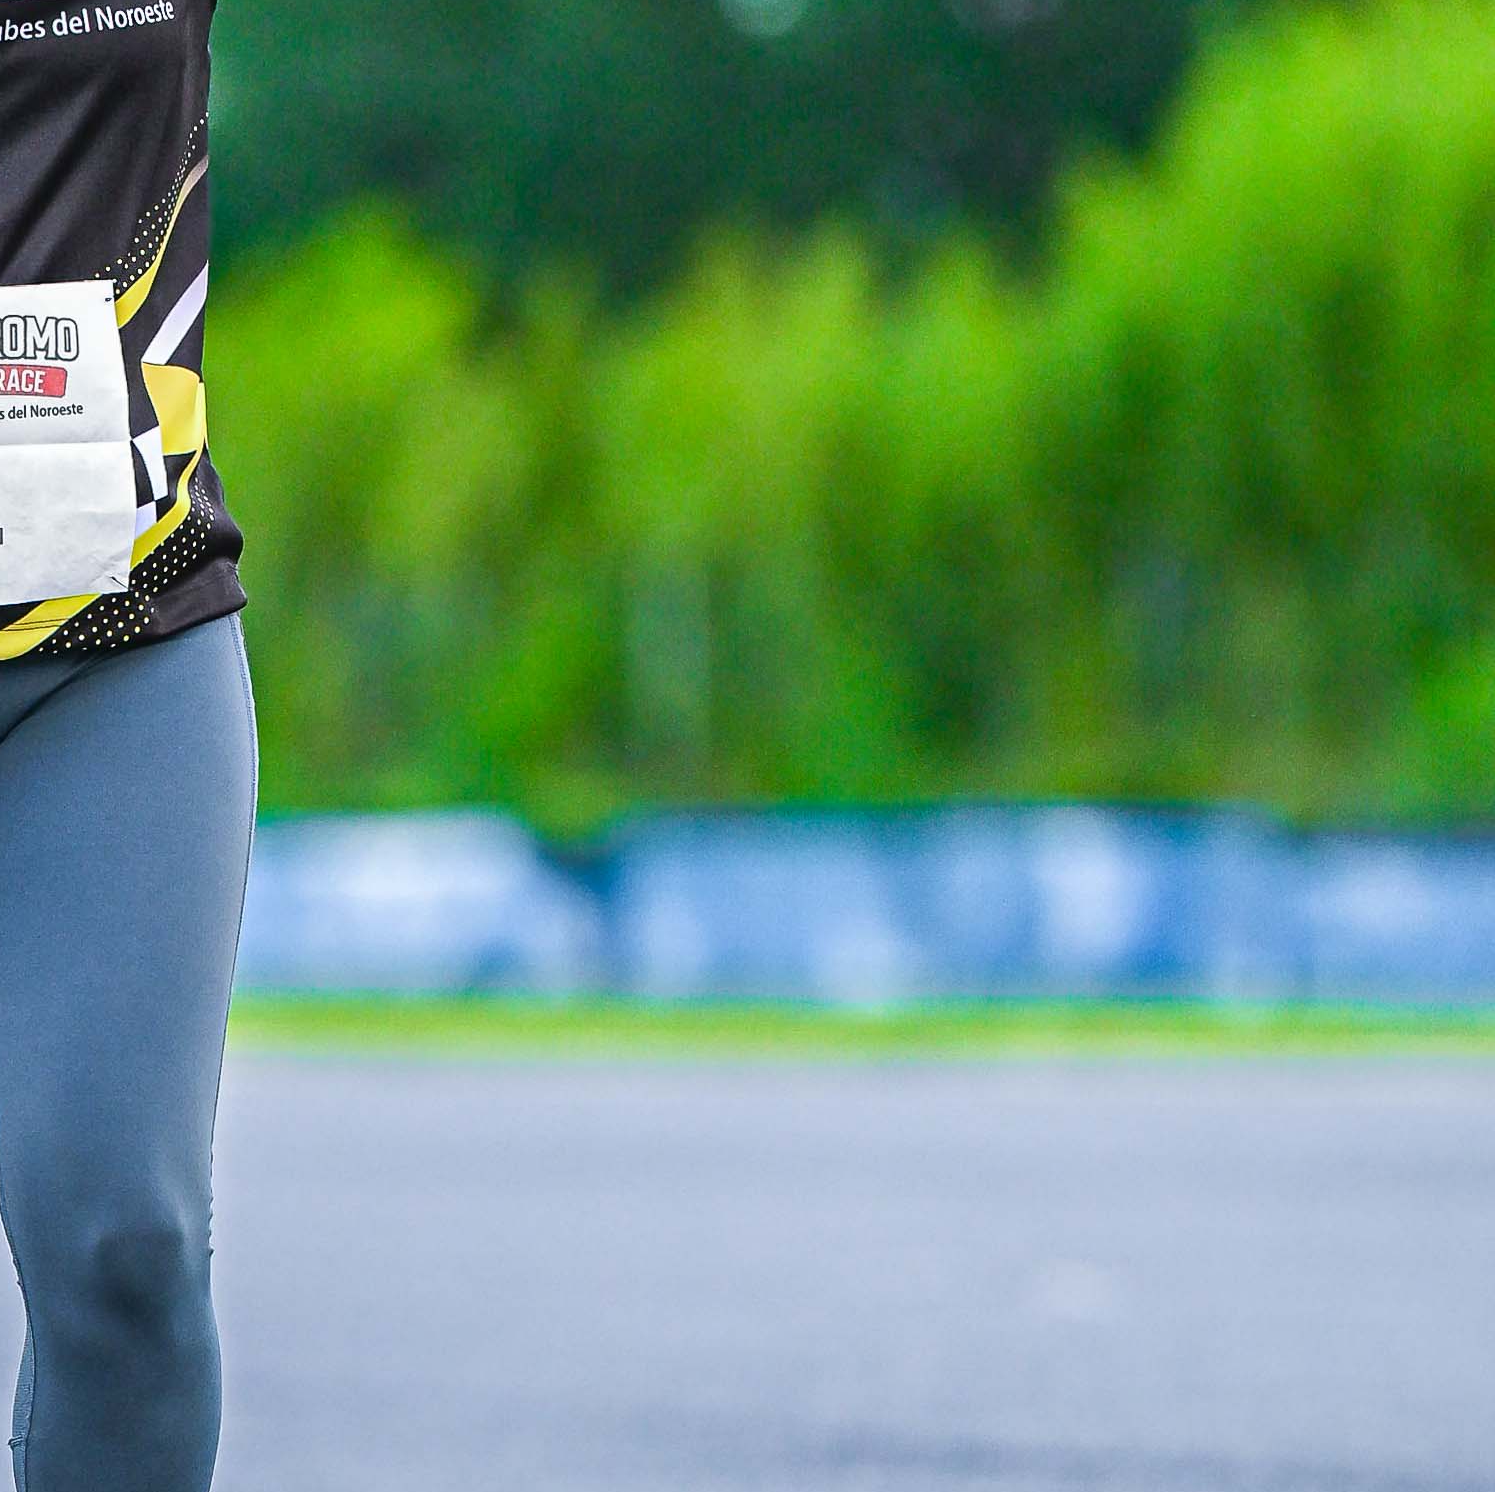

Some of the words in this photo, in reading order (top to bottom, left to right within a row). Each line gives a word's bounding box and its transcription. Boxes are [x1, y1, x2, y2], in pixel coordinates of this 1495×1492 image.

[52, 8, 90, 36] del
[94, 0, 175, 31] Noroeste
[8, 406, 27, 419] del
[30, 404, 84, 418] Noroeste
